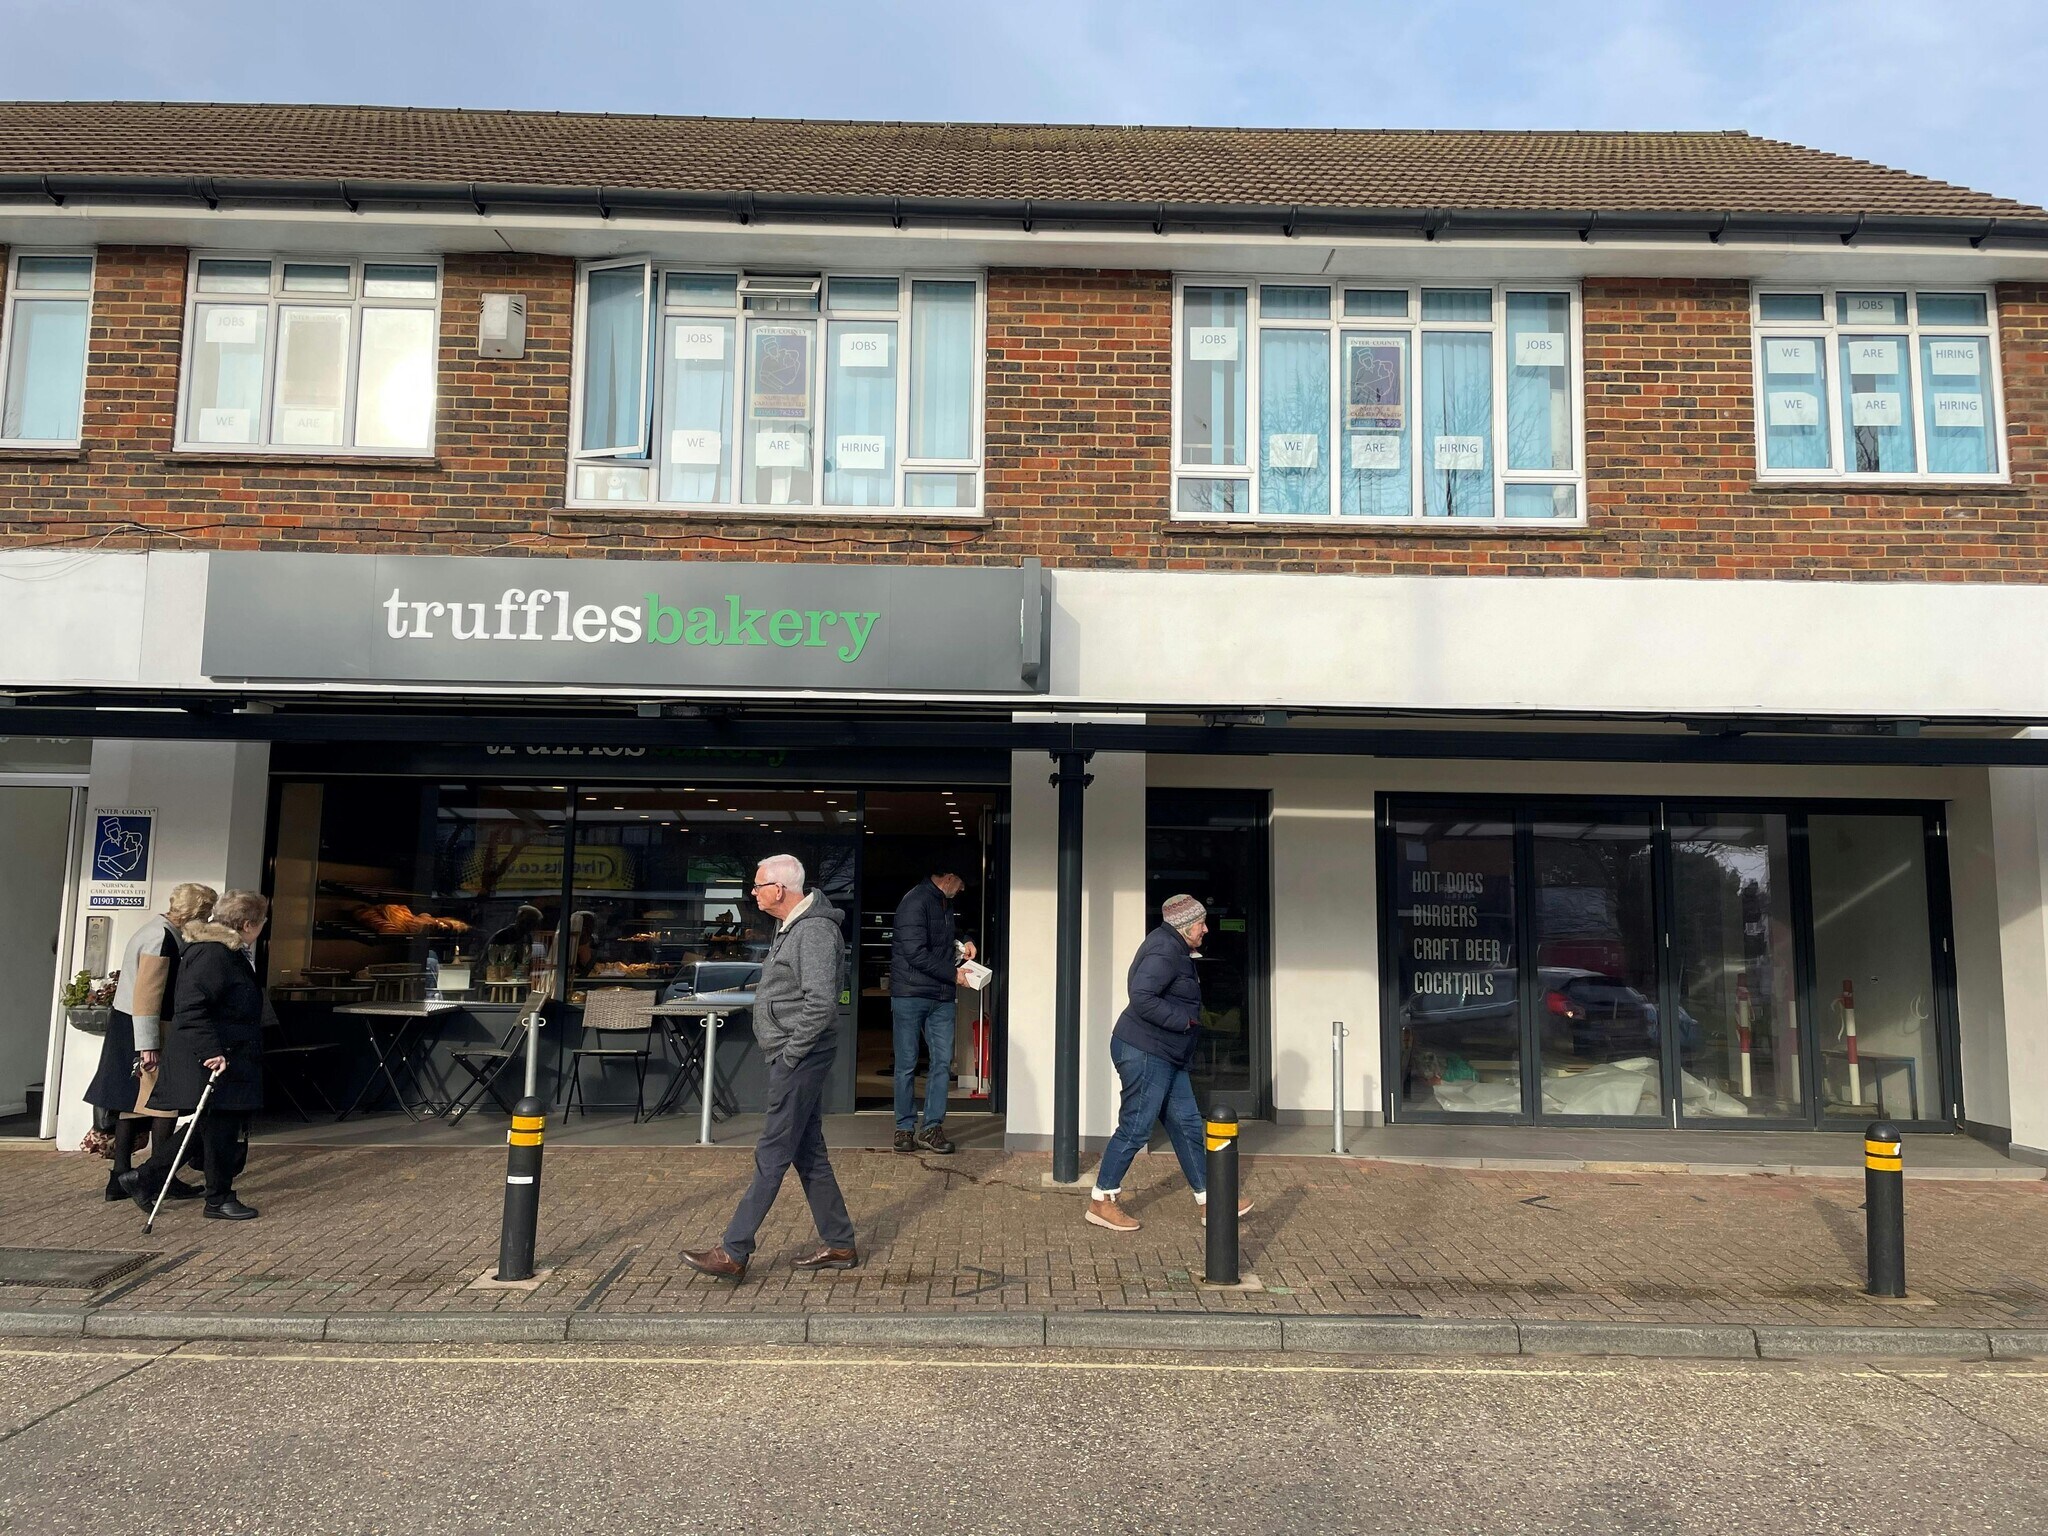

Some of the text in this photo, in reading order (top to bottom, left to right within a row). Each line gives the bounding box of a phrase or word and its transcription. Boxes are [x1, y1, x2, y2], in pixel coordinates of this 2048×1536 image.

[1857, 299, 1883, 310] JOBS
[217, 316, 245, 327] JOBS
[686, 333, 713, 344] JOBS
[1200, 334, 1227, 345] JOBS
[851, 340, 877, 351] JOBS
[1526, 340, 1553, 351] JOBS
[1781, 348, 1800, 358] WE
[1863, 348, 1884, 359] ARE
[1936, 349, 1974, 359] HIRING
[1784, 399, 1803, 410] WE
[1865, 400, 1887, 410] ARE
[1939, 401, 1978, 411] HIRING
[216, 416, 235, 426] WE
[297, 418, 320, 428] ARE
[687, 438, 705, 448] WE
[769, 440, 790, 450] ARE
[841, 442, 880, 453] HIRING
[1284, 441, 1303, 451] WE
[1364, 442, 1386, 453] ARE
[1439, 443, 1478, 454] HIRING
[1412, 870, 1440, 893] HOT
[1446, 871, 1484, 895] DOGS
[92, 897, 142, 906] 01903 782555
[1413, 904, 1478, 928] BURGERS
[1413, 938, 1501, 962] CRAFT BEER
[1414, 971, 1494, 996] COCKTAILS
